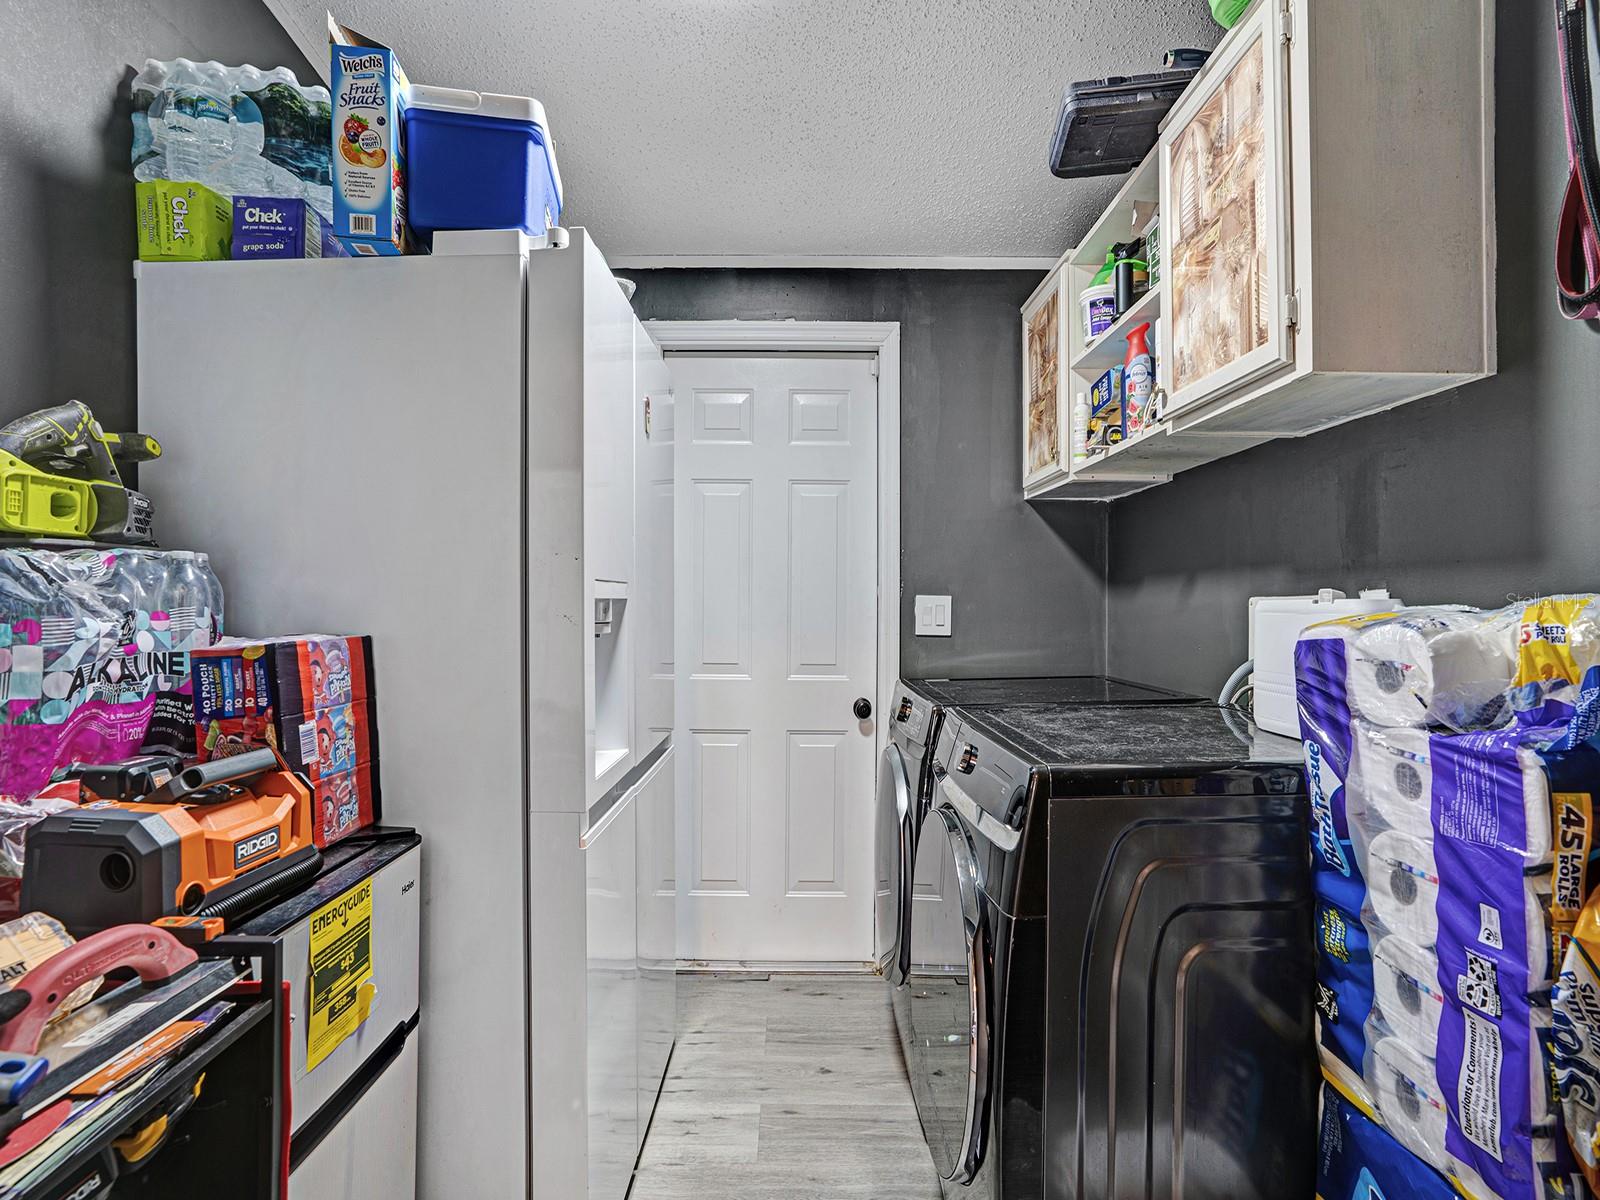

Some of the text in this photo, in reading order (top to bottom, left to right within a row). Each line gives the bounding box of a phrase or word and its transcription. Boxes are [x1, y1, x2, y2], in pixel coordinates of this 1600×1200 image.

[341, 56, 382, 72] Welch's
[349, 82, 380, 96] Fruit
[339, 93, 386, 107] Snacks
[171, 197, 189, 240] Chek
[245, 208, 282, 223] Chek
[243, 244, 264, 252] grape
[64, 651, 185, 702] ALKALINE
[200, 664, 212, 714] 40 POUCH
[225, 699, 233, 712] 20
[234, 698, 243, 708] 10
[244, 697, 254, 707] 10
[257, 697, 268, 707] 40
[1561, 805, 1586, 850] 45
[237, 832, 277, 859] RIDGID
[1320, 812, 1346, 870] Bath
[402, 880, 415, 895] Haier
[1568, 854, 1582, 910] LARGE
[312, 884, 371, 936] ENERGYGUIDE
[1463, 1013, 1475, 1136] Questions or Comments?
[1472, 1094, 1481, 1108] love
[1481, 1097, 1489, 1114] Mark
[1471, 1107, 1480, 1129] would
